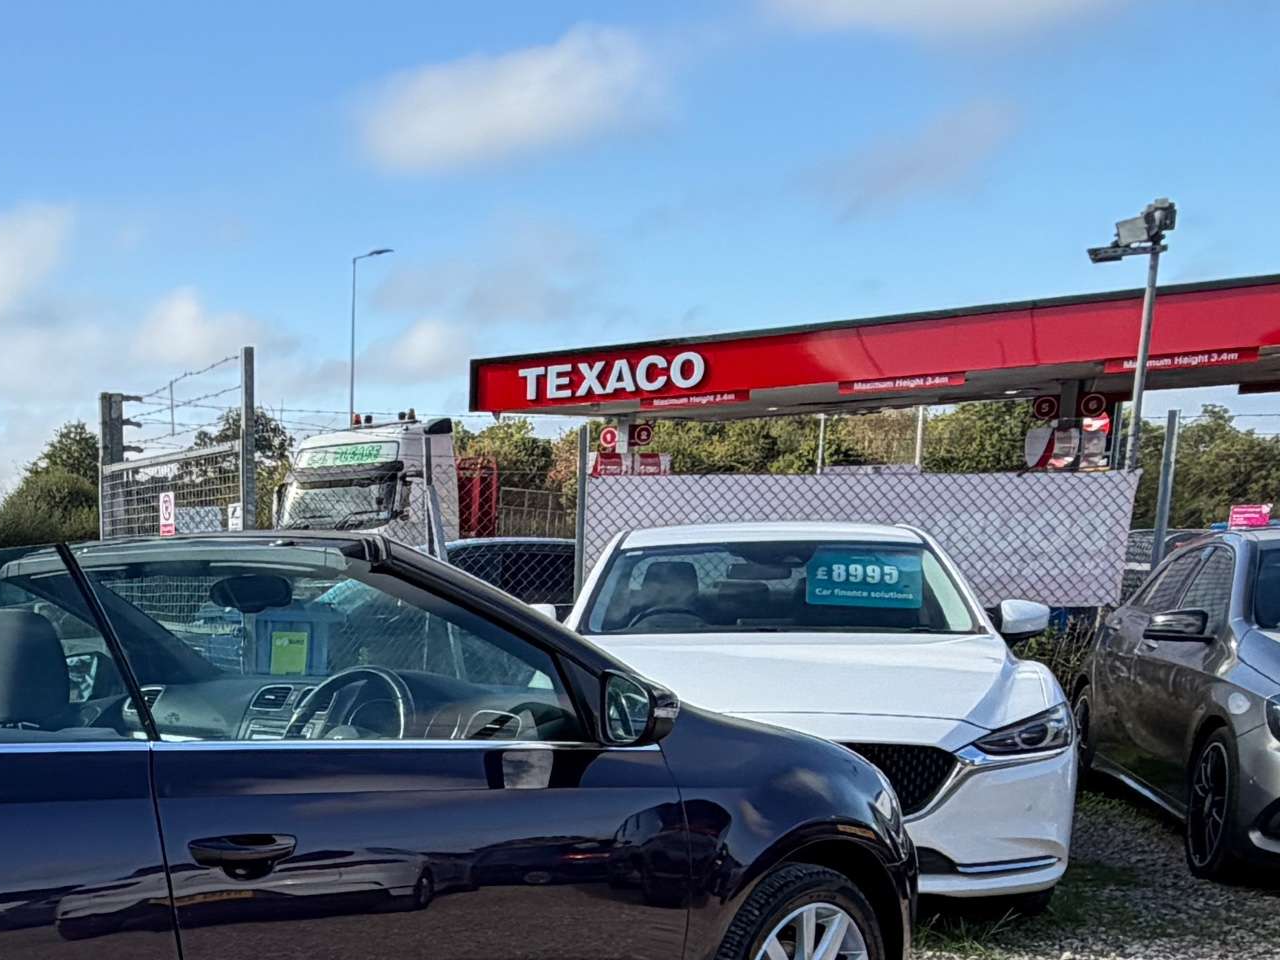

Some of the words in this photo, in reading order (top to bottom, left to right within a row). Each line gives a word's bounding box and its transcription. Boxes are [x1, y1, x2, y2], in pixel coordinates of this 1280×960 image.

[1123, 359, 1171, 369] Mamum
[1174, 353, 1208, 366] Height
[1210, 352, 1239, 362] 3.4m
[518, 351, 705, 400] TEXACO
[895, 378, 924, 388] Height
[640, 430, 648, 440] 2
[815, 587, 832, 596] Car
[834, 588, 868, 597] finance
[870, 590, 914, 600] solutions
